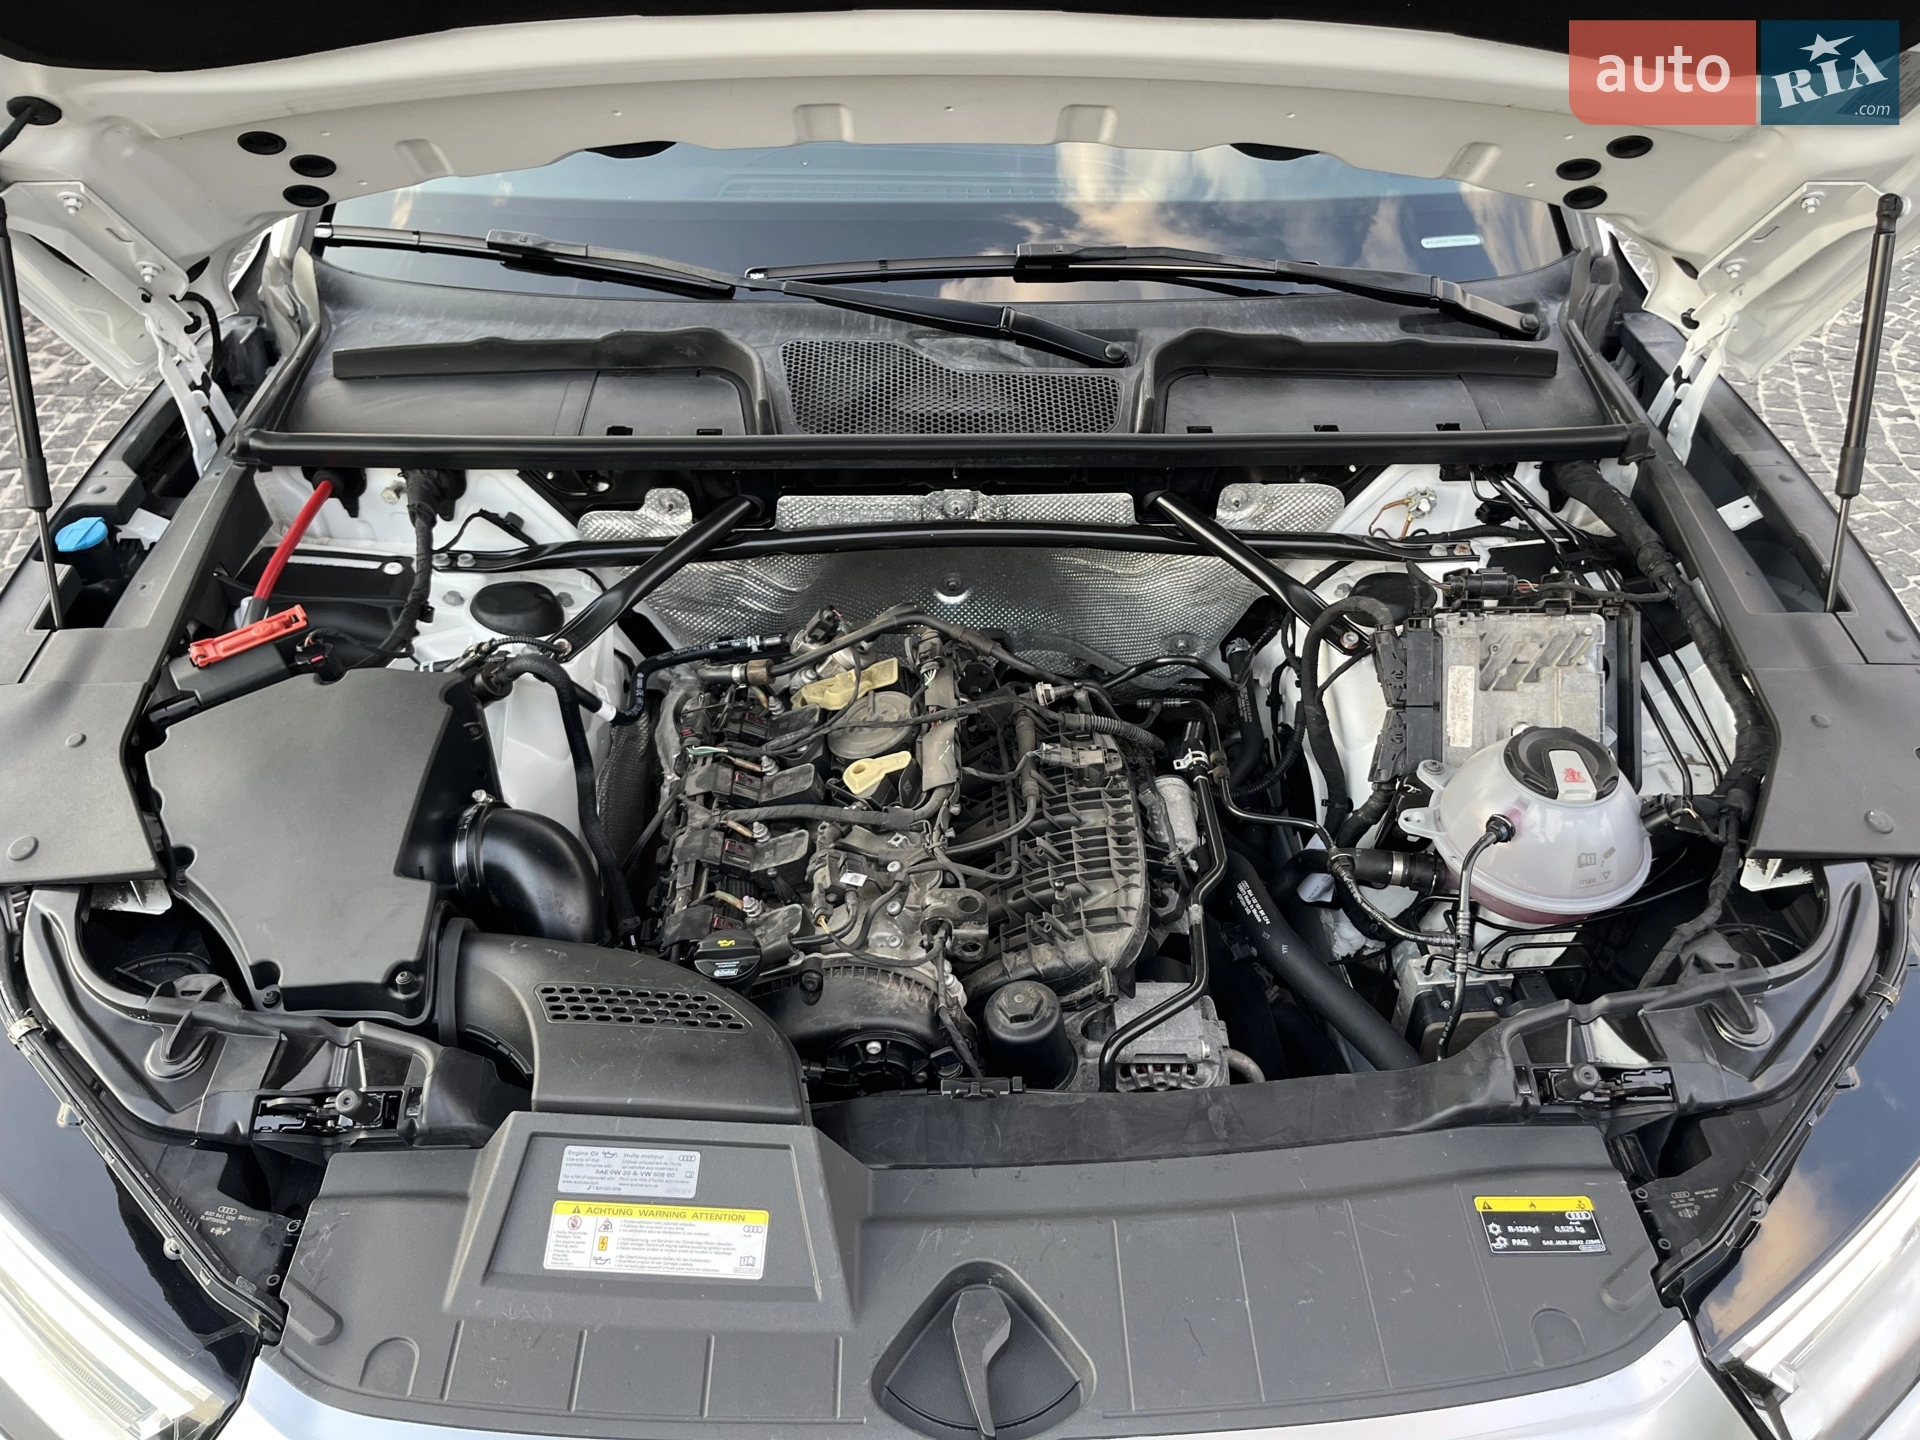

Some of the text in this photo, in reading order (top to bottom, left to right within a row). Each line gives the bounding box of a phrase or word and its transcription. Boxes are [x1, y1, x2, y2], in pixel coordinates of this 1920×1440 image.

[586, 1207, 746, 1222] ACHTUNG WARNING ATTENTION
[1507, 1225, 1540, 1234] R-1234yf
